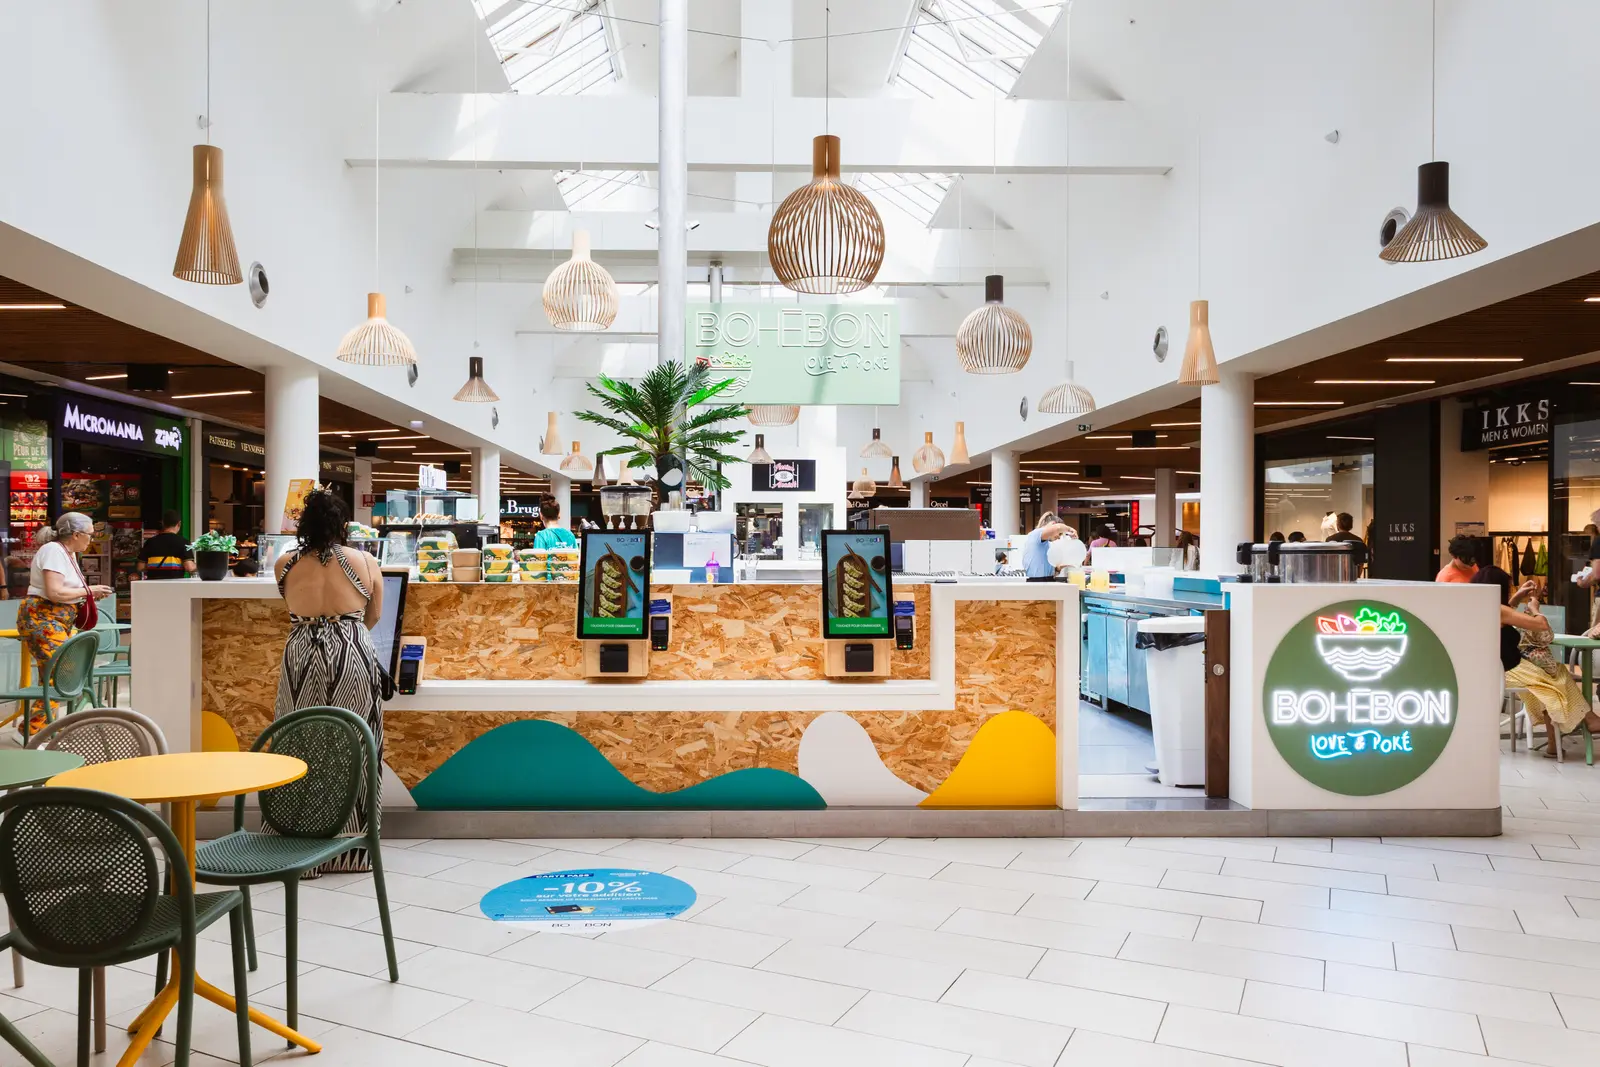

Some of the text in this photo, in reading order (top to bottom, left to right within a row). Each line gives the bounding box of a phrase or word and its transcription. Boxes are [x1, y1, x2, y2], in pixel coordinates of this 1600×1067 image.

[804, 354, 837, 376] LOVE
[1482, 399, 1549, 430] IKKS
[1481, 422, 1548, 443] MEN & WOMEN
[506, 499, 540, 517] Brug
[1389, 523, 1415, 533] IKKS
[1311, 730, 1413, 759] LOVE & POKÉ
